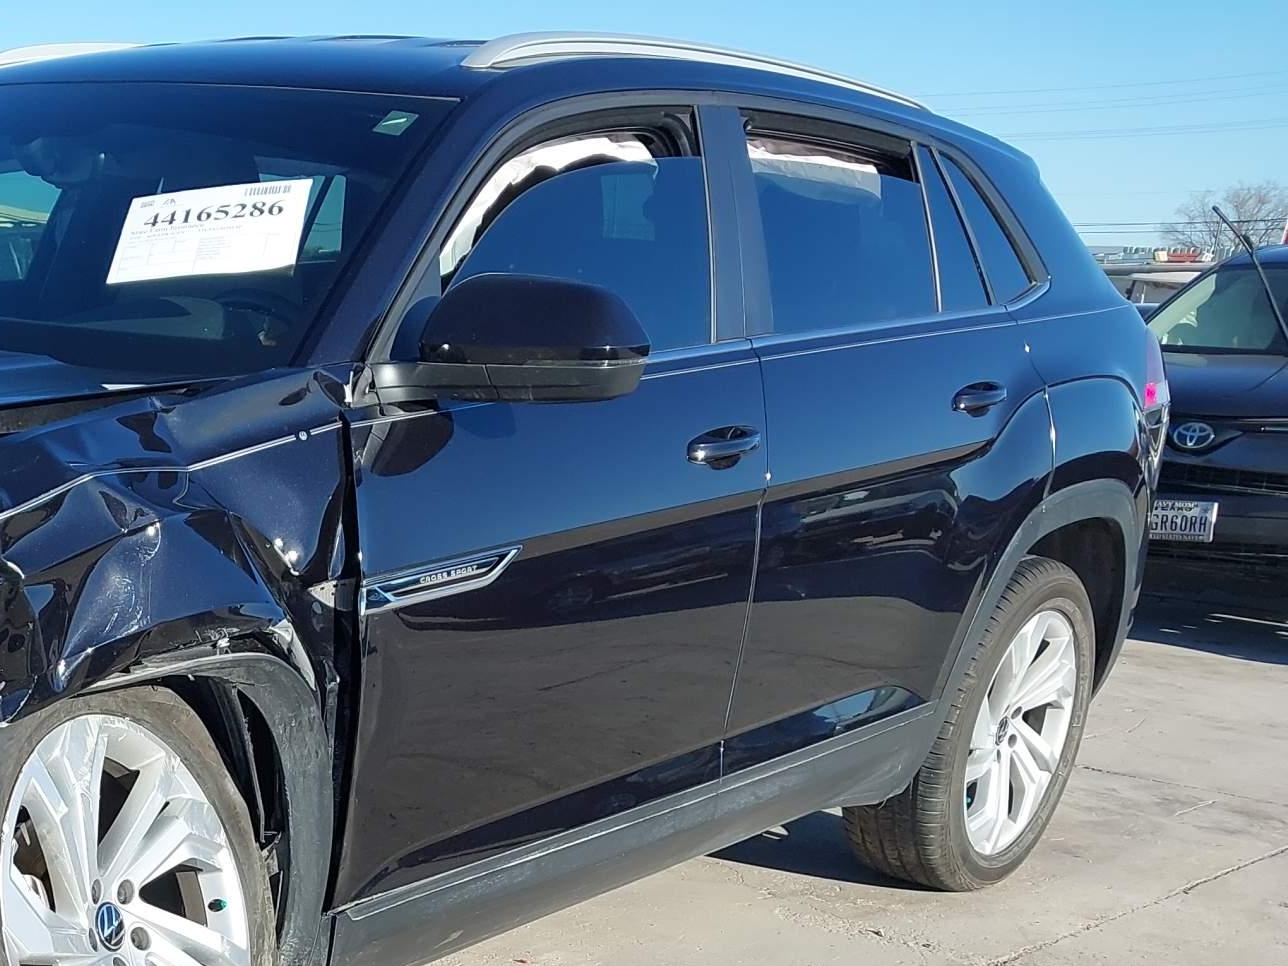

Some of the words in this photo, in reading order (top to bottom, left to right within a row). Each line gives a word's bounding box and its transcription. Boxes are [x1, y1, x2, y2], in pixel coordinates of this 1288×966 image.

[144, 200, 285, 227] 44165286
[420, 573, 448, 583] CROSS
[450, 565, 478, 577] SPORT
